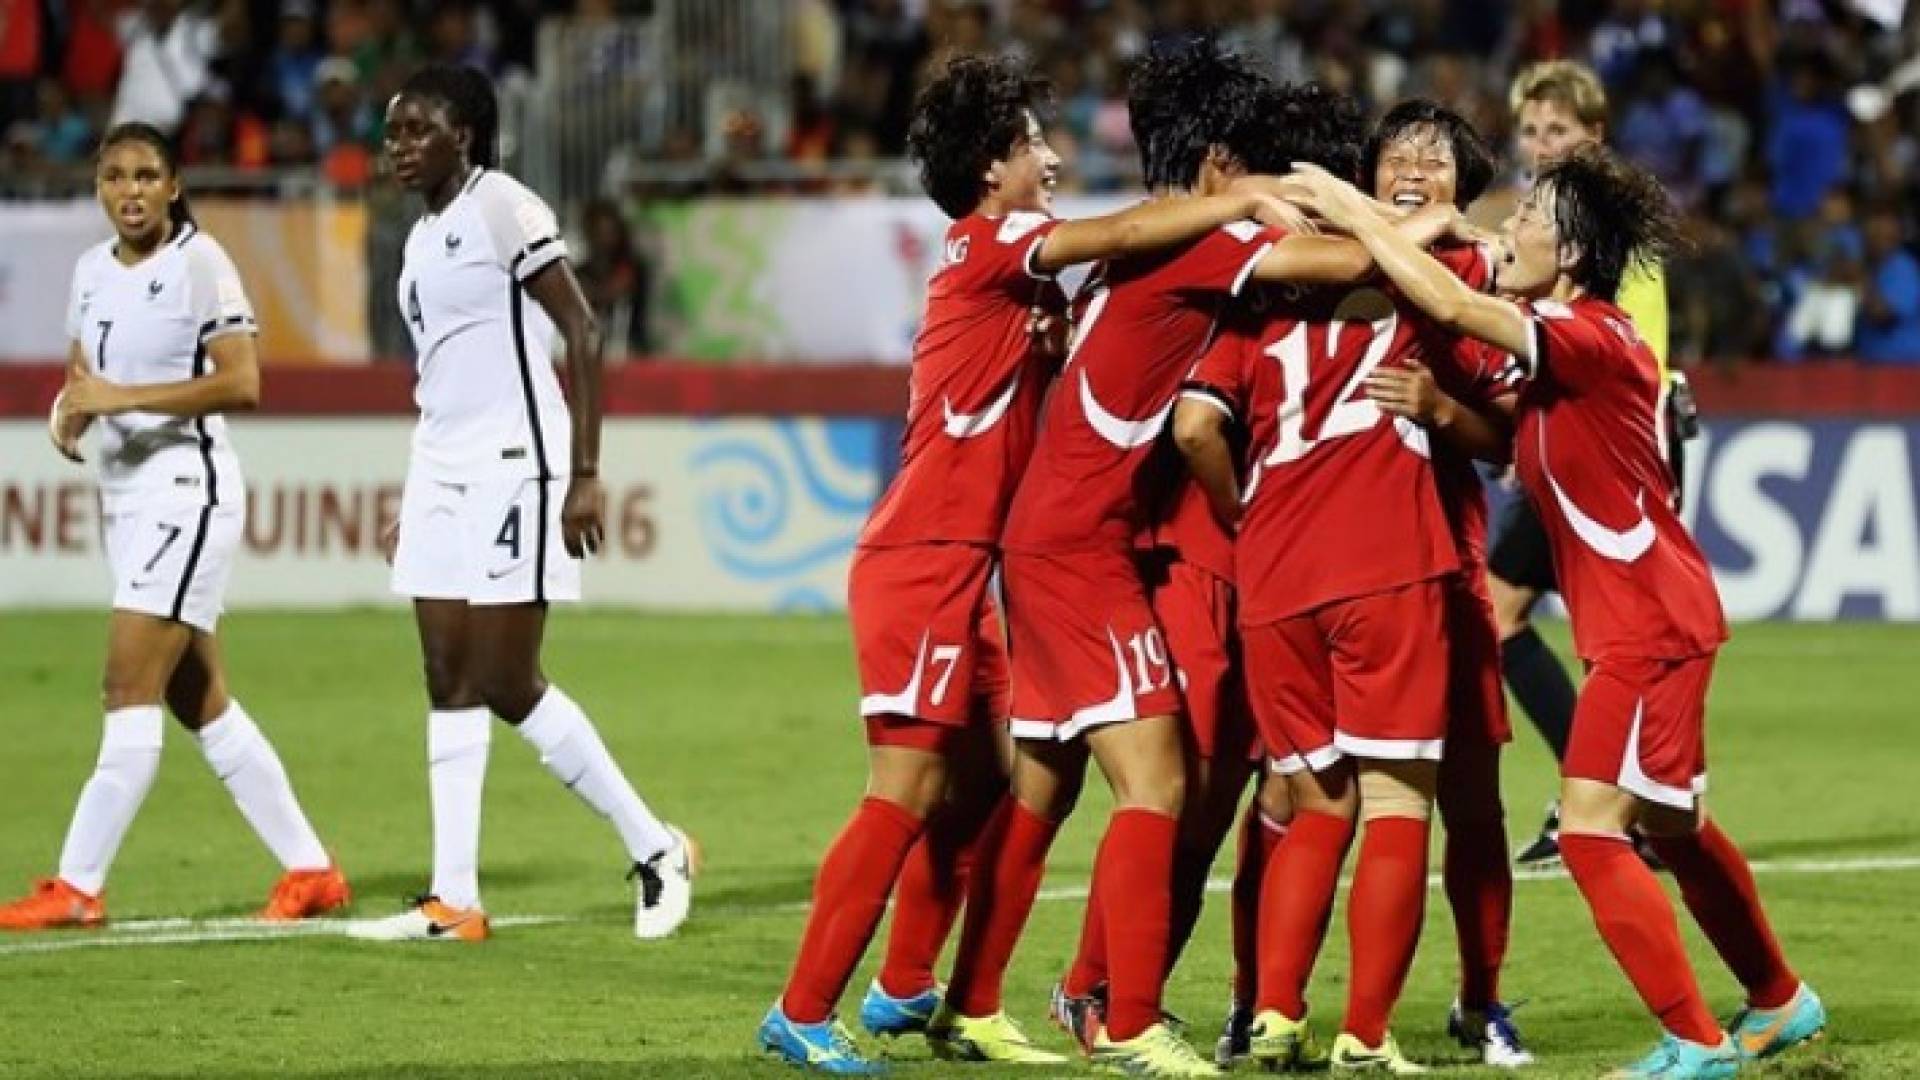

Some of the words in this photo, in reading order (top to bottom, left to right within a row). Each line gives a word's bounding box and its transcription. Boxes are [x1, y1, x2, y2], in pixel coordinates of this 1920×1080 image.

[407, 280, 425, 333] 4
[96, 319, 114, 371] 7
[1263, 287, 1398, 467] 12
[0, 483, 103, 553] NE
[243, 482, 401, 556] UINE
[142, 521, 181, 572] 7
[494, 504, 521, 559] 4
[1682, 421, 1920, 621] SA
[928, 643, 962, 706] 7
[1129, 627, 1170, 695] 19
